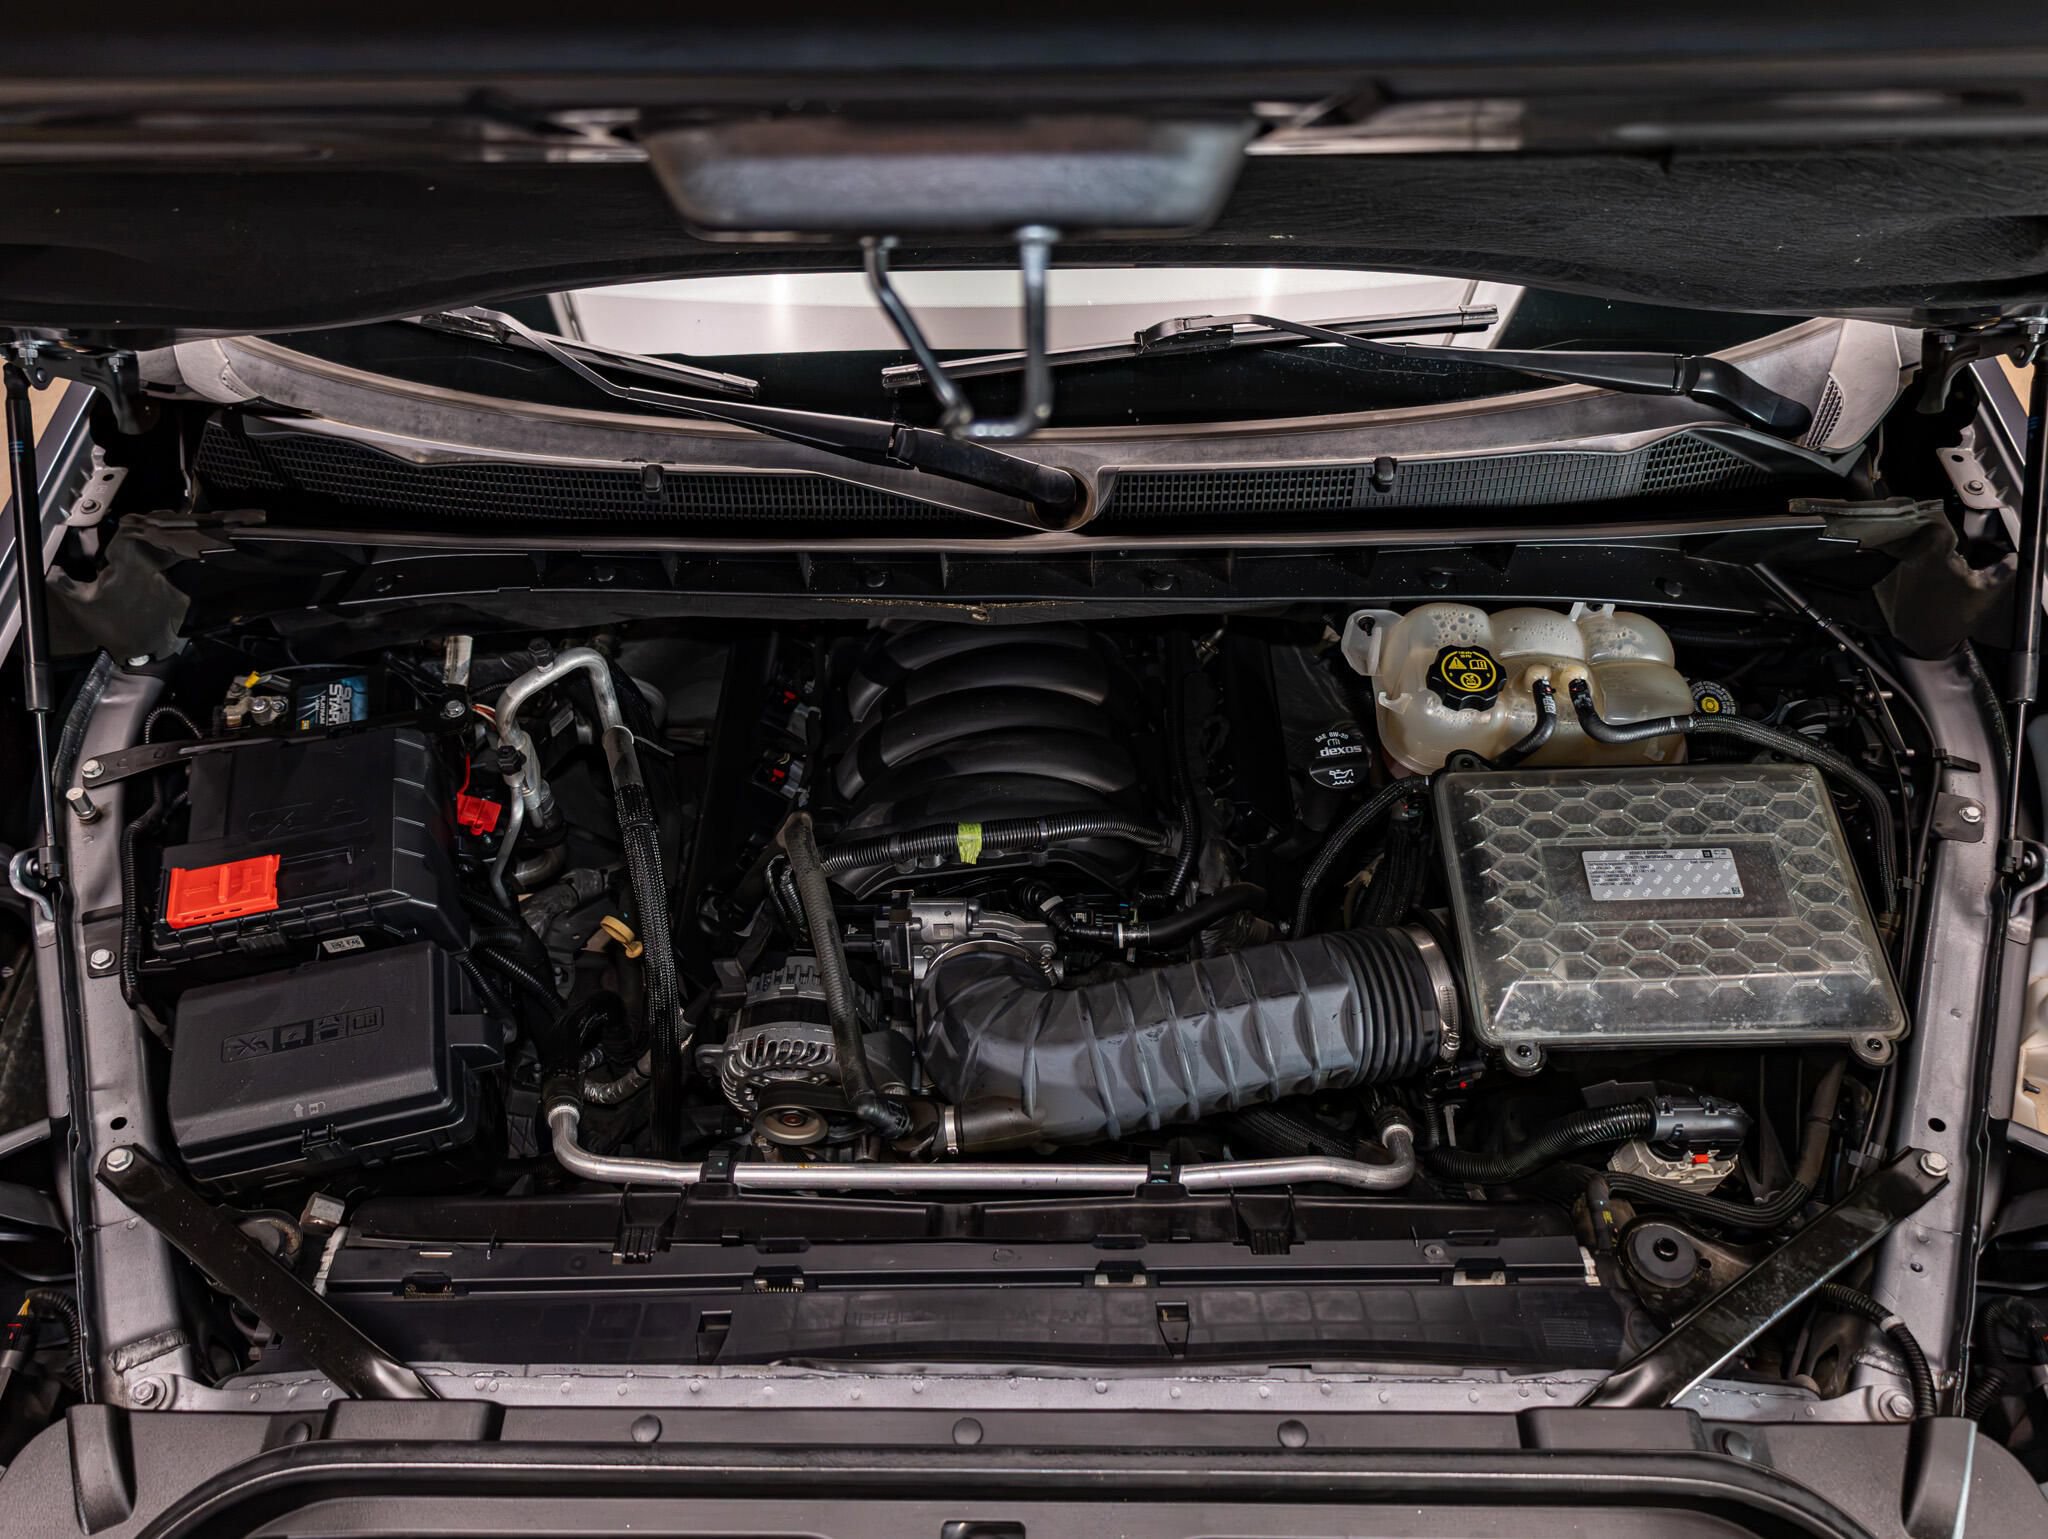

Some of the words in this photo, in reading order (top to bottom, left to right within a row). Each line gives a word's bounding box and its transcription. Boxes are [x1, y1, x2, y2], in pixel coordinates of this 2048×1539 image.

[341, 687, 352, 723] SUPE
[1315, 733, 1328, 743] SAE
[1320, 745, 1362, 757] dexos
